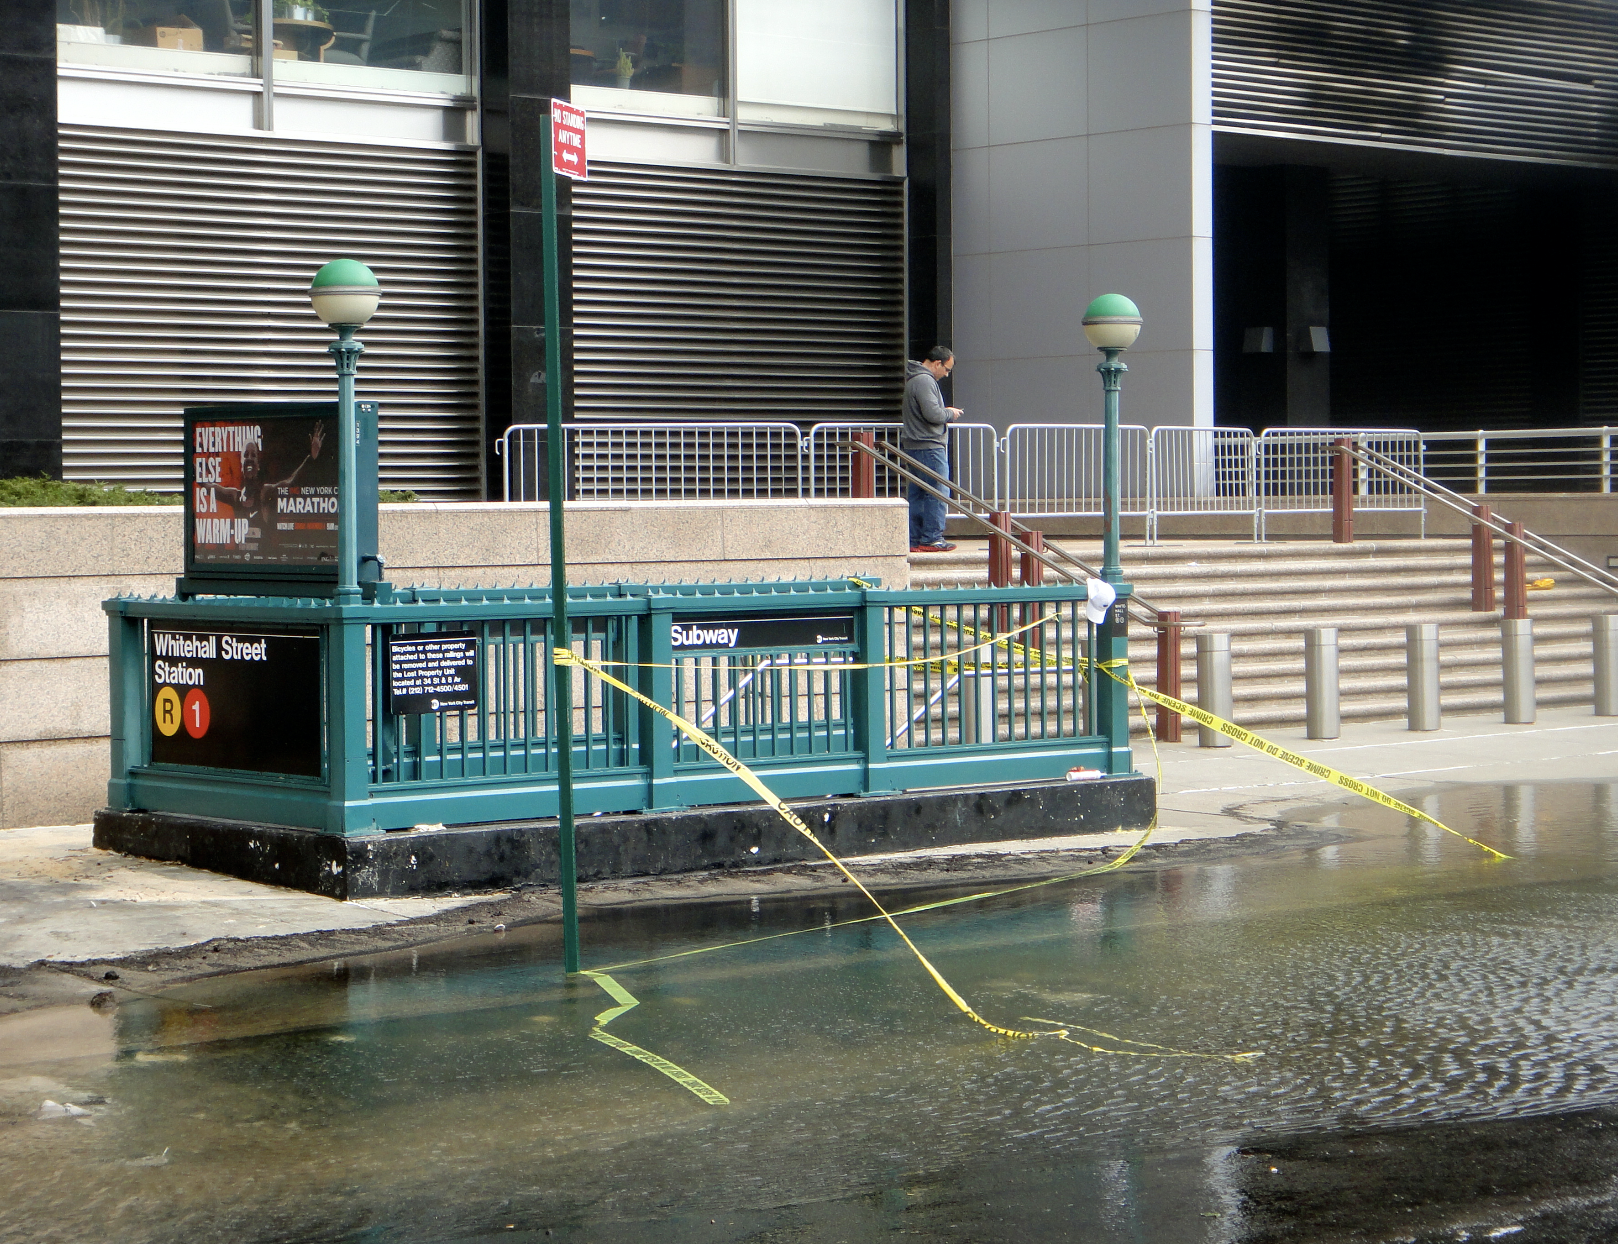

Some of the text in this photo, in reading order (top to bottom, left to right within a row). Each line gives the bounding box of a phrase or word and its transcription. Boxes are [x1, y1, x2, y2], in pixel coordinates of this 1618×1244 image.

[554, 108, 584, 130] NO STANDING
[558, 129, 582, 148] ANYTIME
[195, 425, 262, 453] EVERYTHING
[195, 457, 222, 483] ELSE
[277, 487, 289, 495] THE
[301, 487, 316, 495] NEW
[316, 486, 333, 495] YORK
[195, 487, 217, 513] IS A
[277, 497, 339, 514] MARATHO
[195, 518, 249, 545] WARM-UP
[671, 625, 739, 648] Subway
[154, 633, 267, 661] Whitehall Street
[391, 645, 416, 653] Bicycles
[425, 643, 441, 651] other
[441, 642, 466, 651] property
[392, 653, 417, 661] attached
[426, 651, 444, 659] these
[444, 651, 464, 659] railings
[154, 660, 204, 686] Station
[392, 662, 401, 670] be
[401, 661, 427, 669] removed
[427, 660, 439, 668] and
[440, 658, 466, 667] delivered
[418, 668, 443, 677] Property
[443, 667, 456, 675] Unit
[392, 678, 415, 686] located
[422, 677, 432, 685] 34
[408, 686, 423, 695] (212)
[424, 684, 469, 693] 712-4500/4501
[162, 698, 200, 728] R 1
[1161, 697, 1187, 712] SCENE
[1187, 707, 1214, 725] CRIME
[1220, 722, 1331, 779] CRIME SCENE DO NOT CROSS
[1338, 775, 1364, 793] CROSS
[1365, 787, 1380, 800] NOT
[1381, 794, 1392, 805] DO
